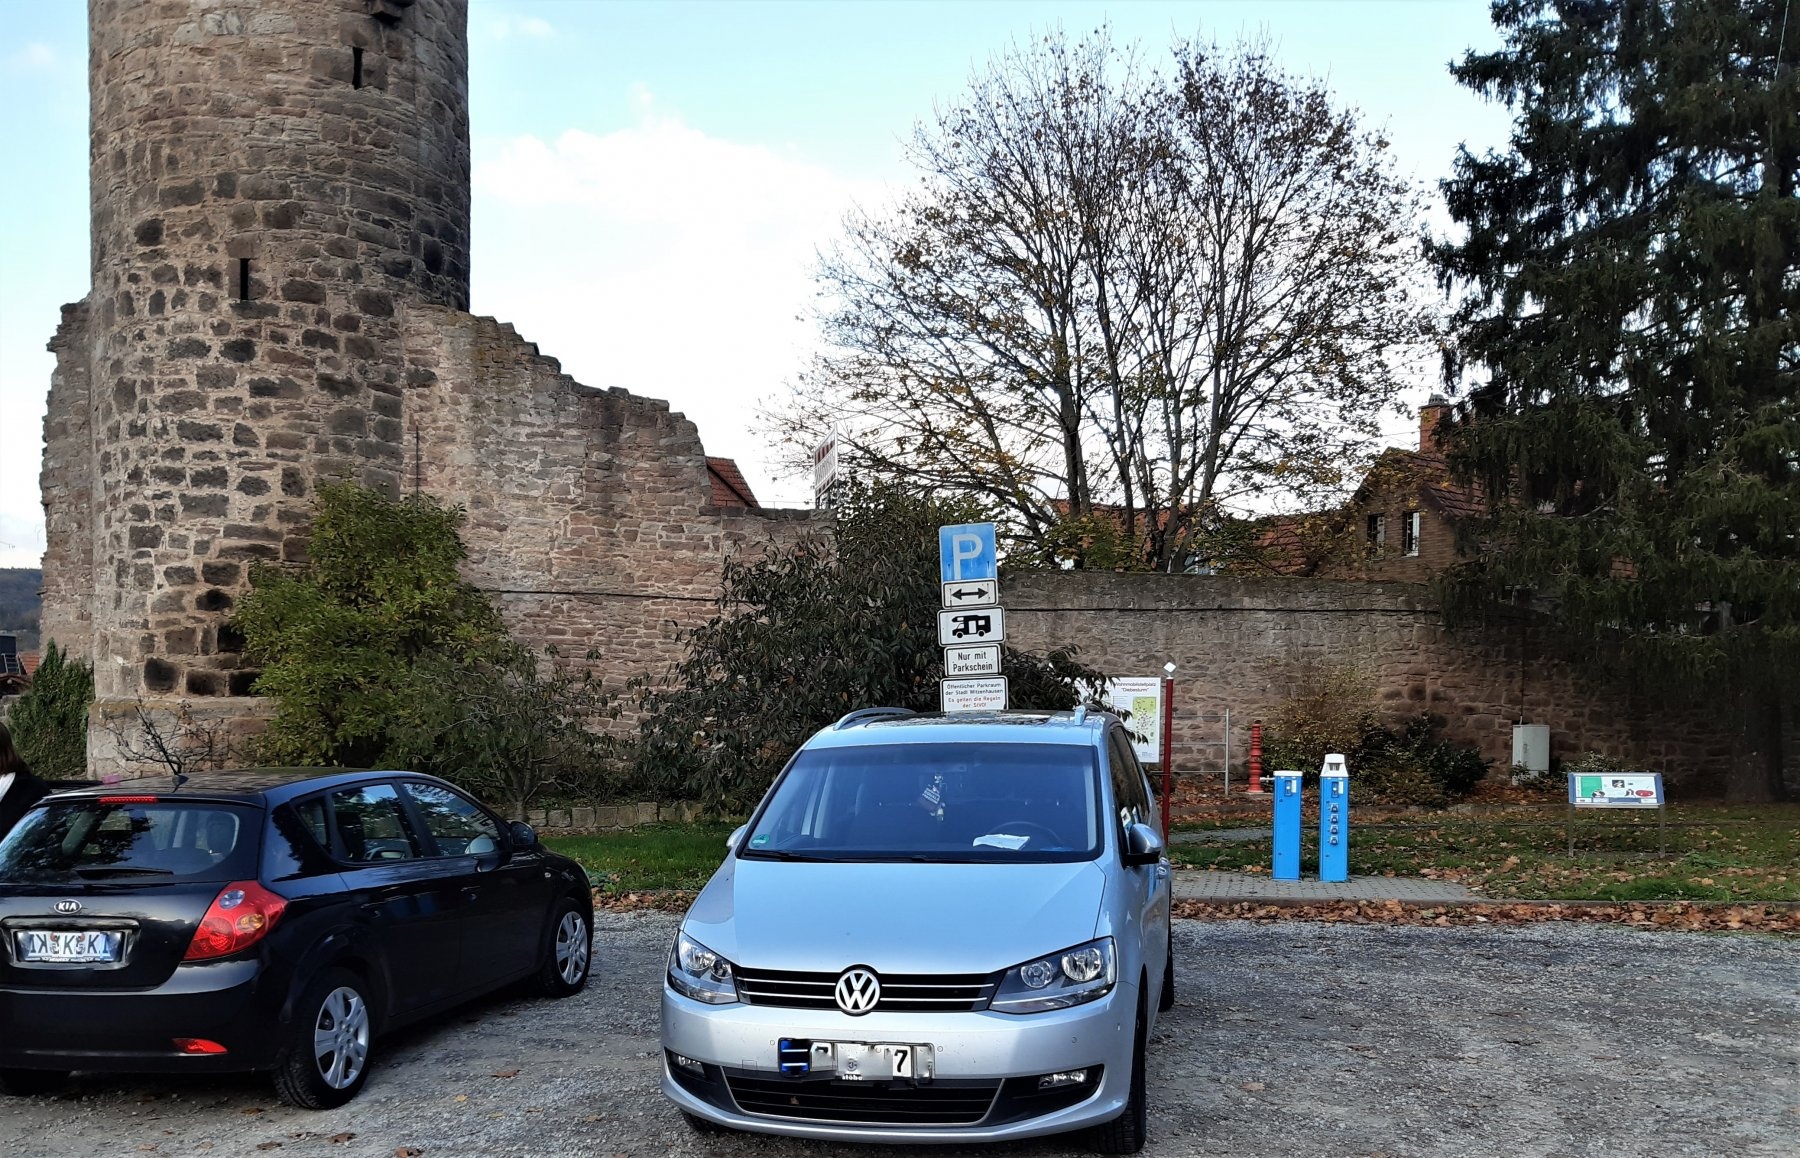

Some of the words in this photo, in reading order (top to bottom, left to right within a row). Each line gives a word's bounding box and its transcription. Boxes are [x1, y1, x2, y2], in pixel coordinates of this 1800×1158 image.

[953, 533, 983, 580] P
[958, 652, 970, 660] Nur
[974, 651, 986, 660] mit
[953, 662, 992, 672] Parkschein
[58, 902, 77, 911] KIA
